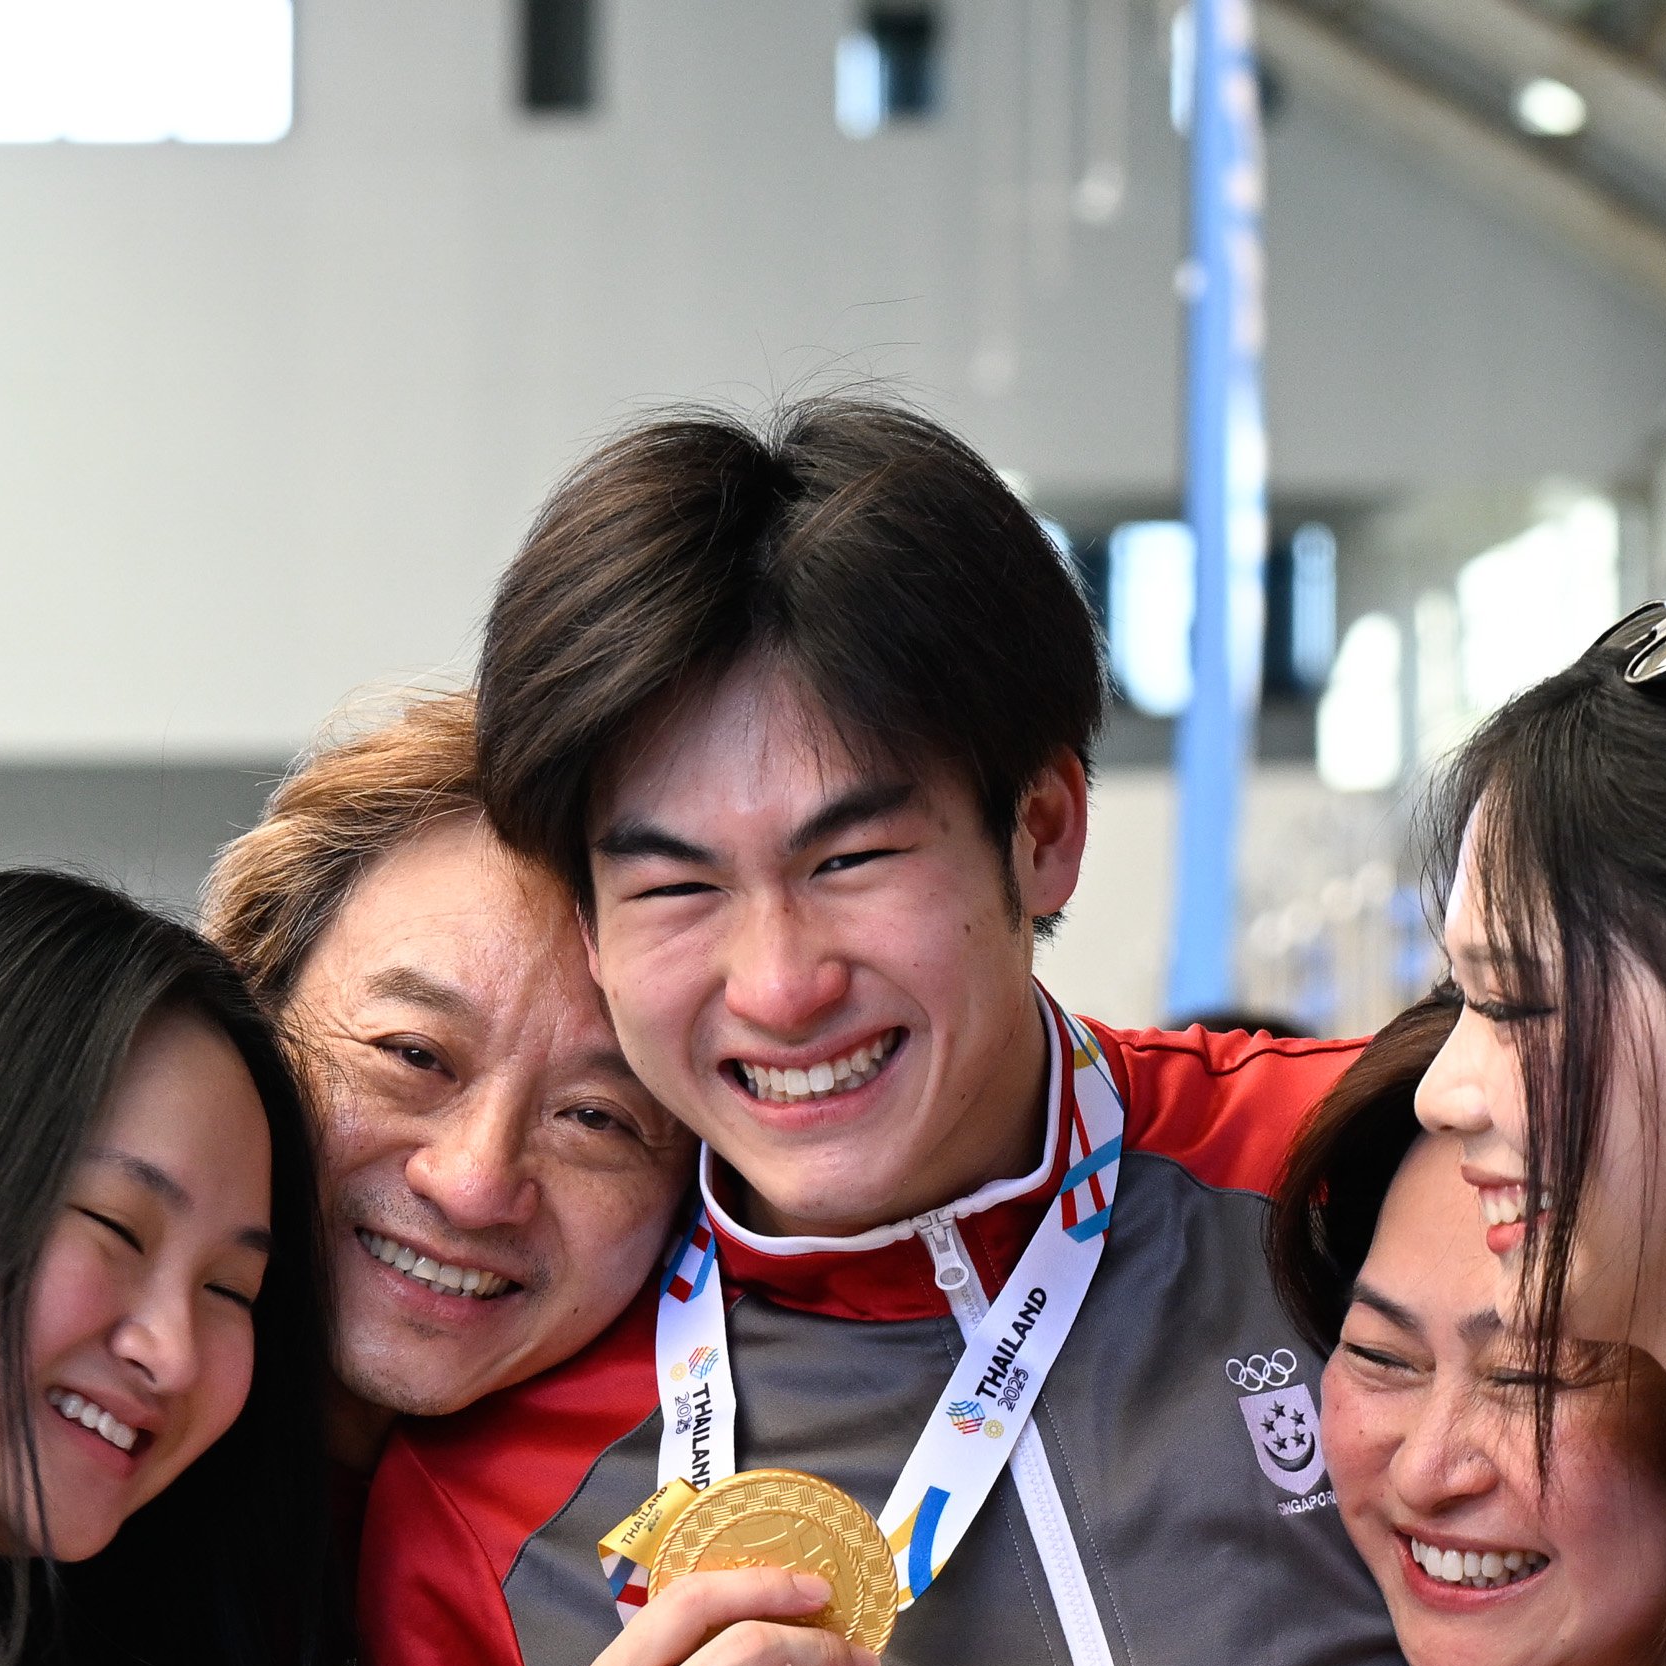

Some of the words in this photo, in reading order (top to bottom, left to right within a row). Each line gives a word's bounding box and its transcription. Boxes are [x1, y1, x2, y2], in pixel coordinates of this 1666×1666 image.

[975, 1287, 1047, 1399] THAILAND
[675, 1392, 692, 1435] 2025
[998, 1366, 1029, 1413] 2025
[692, 1382, 713, 1491] THAILAND
[621, 1486, 668, 1545] THAILAND
